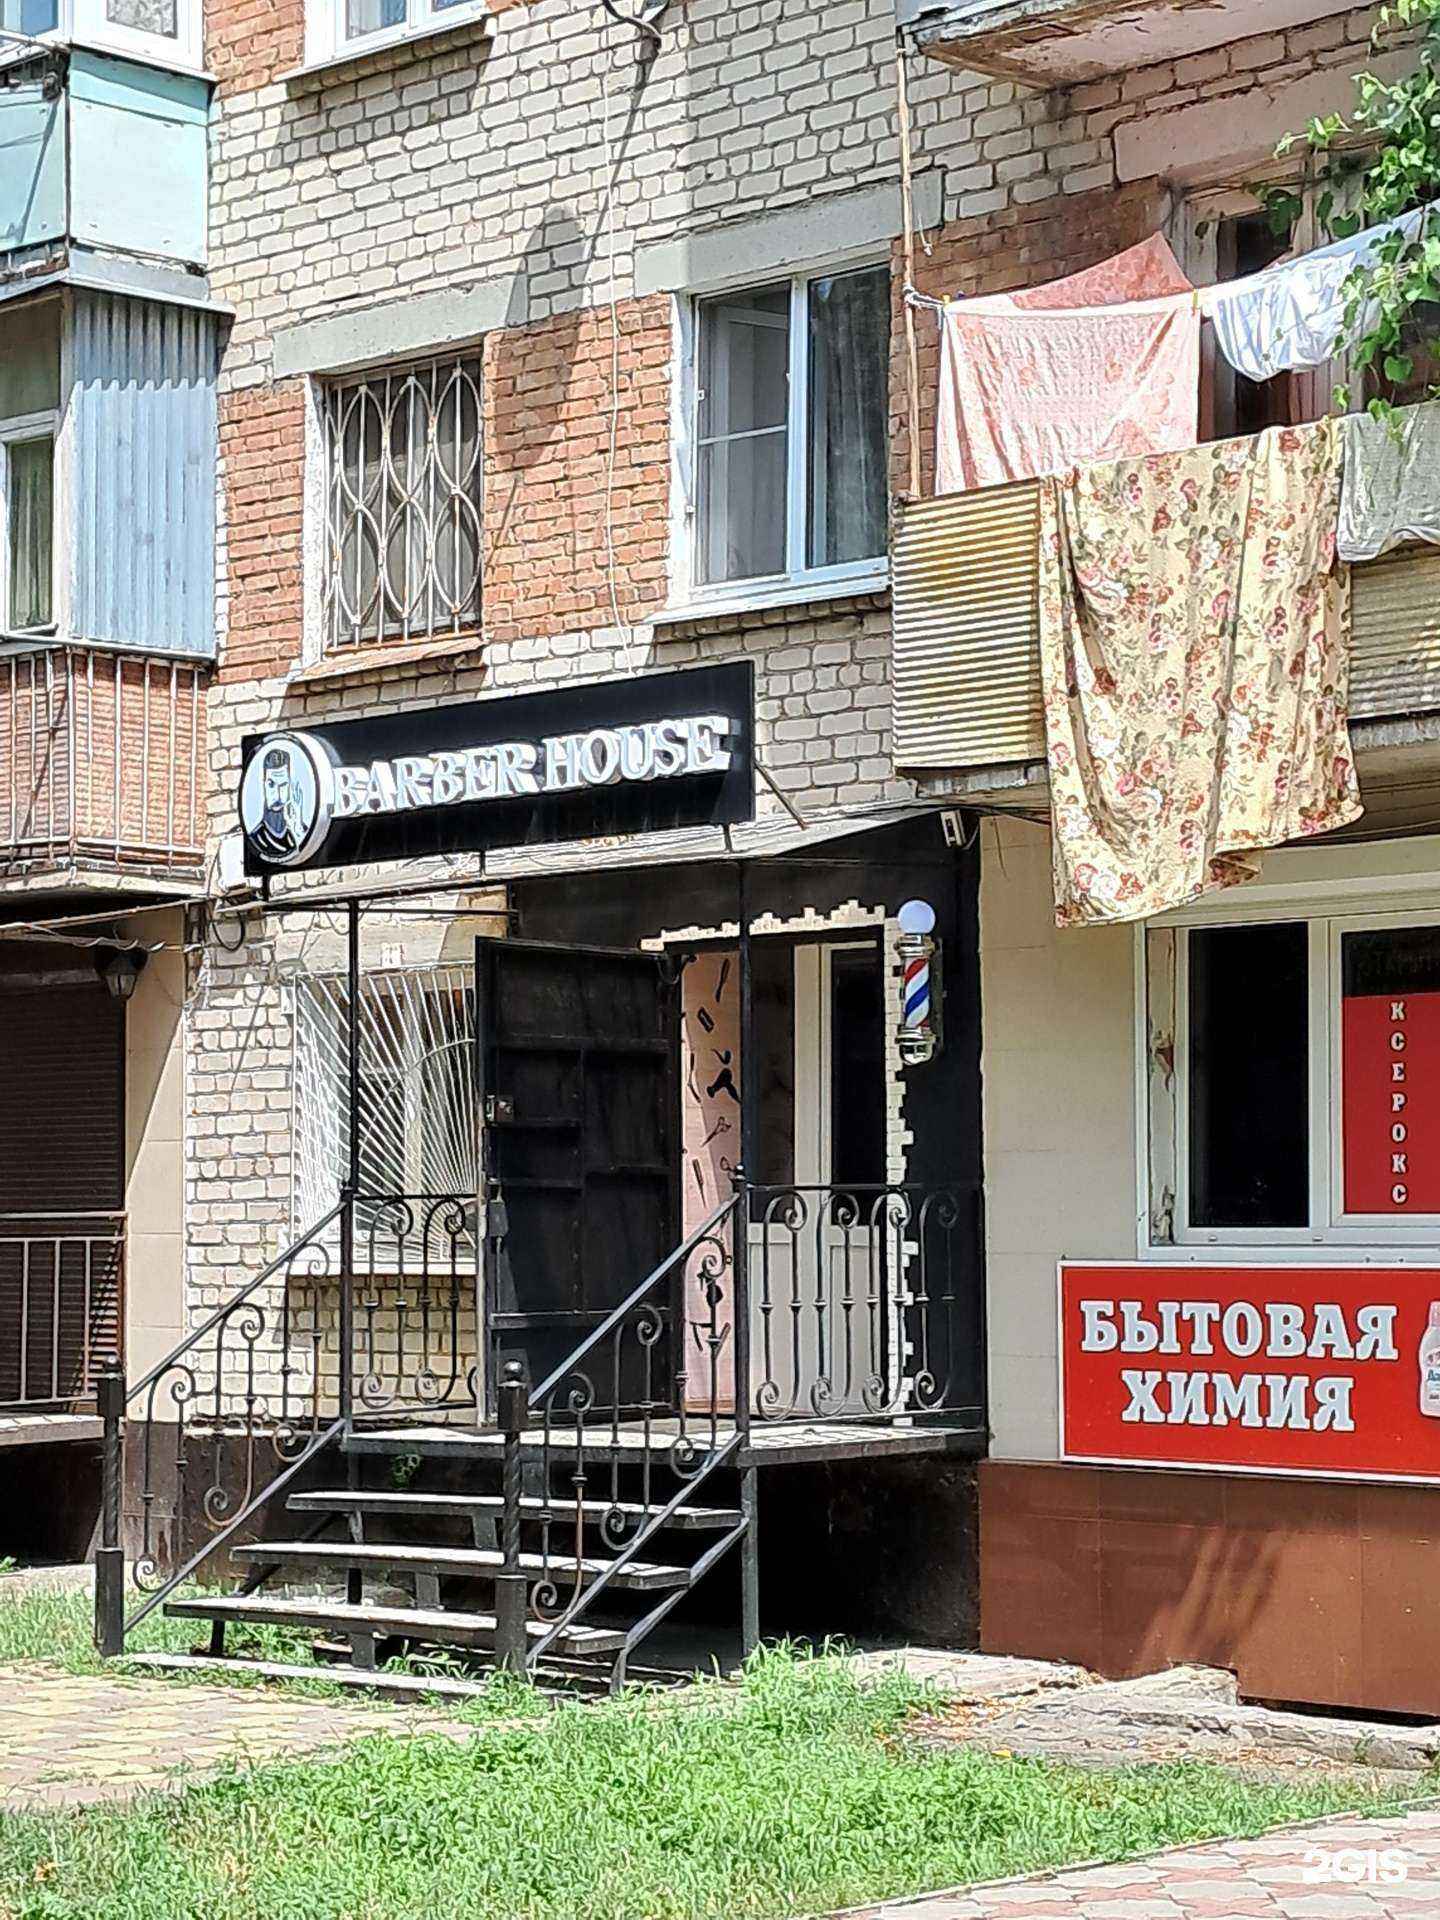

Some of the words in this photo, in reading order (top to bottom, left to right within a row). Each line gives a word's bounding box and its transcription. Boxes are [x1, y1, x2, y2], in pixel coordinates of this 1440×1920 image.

[335, 742, 537, 817] BARBER
[541, 715, 732, 792] HOUSE
[1389, 1002, 1408, 1204] КСЕРОКС
[1080, 1300, 1399, 1361] БЫТОВАЯ
[1120, 1369, 1355, 1432] ХИМИЯ
